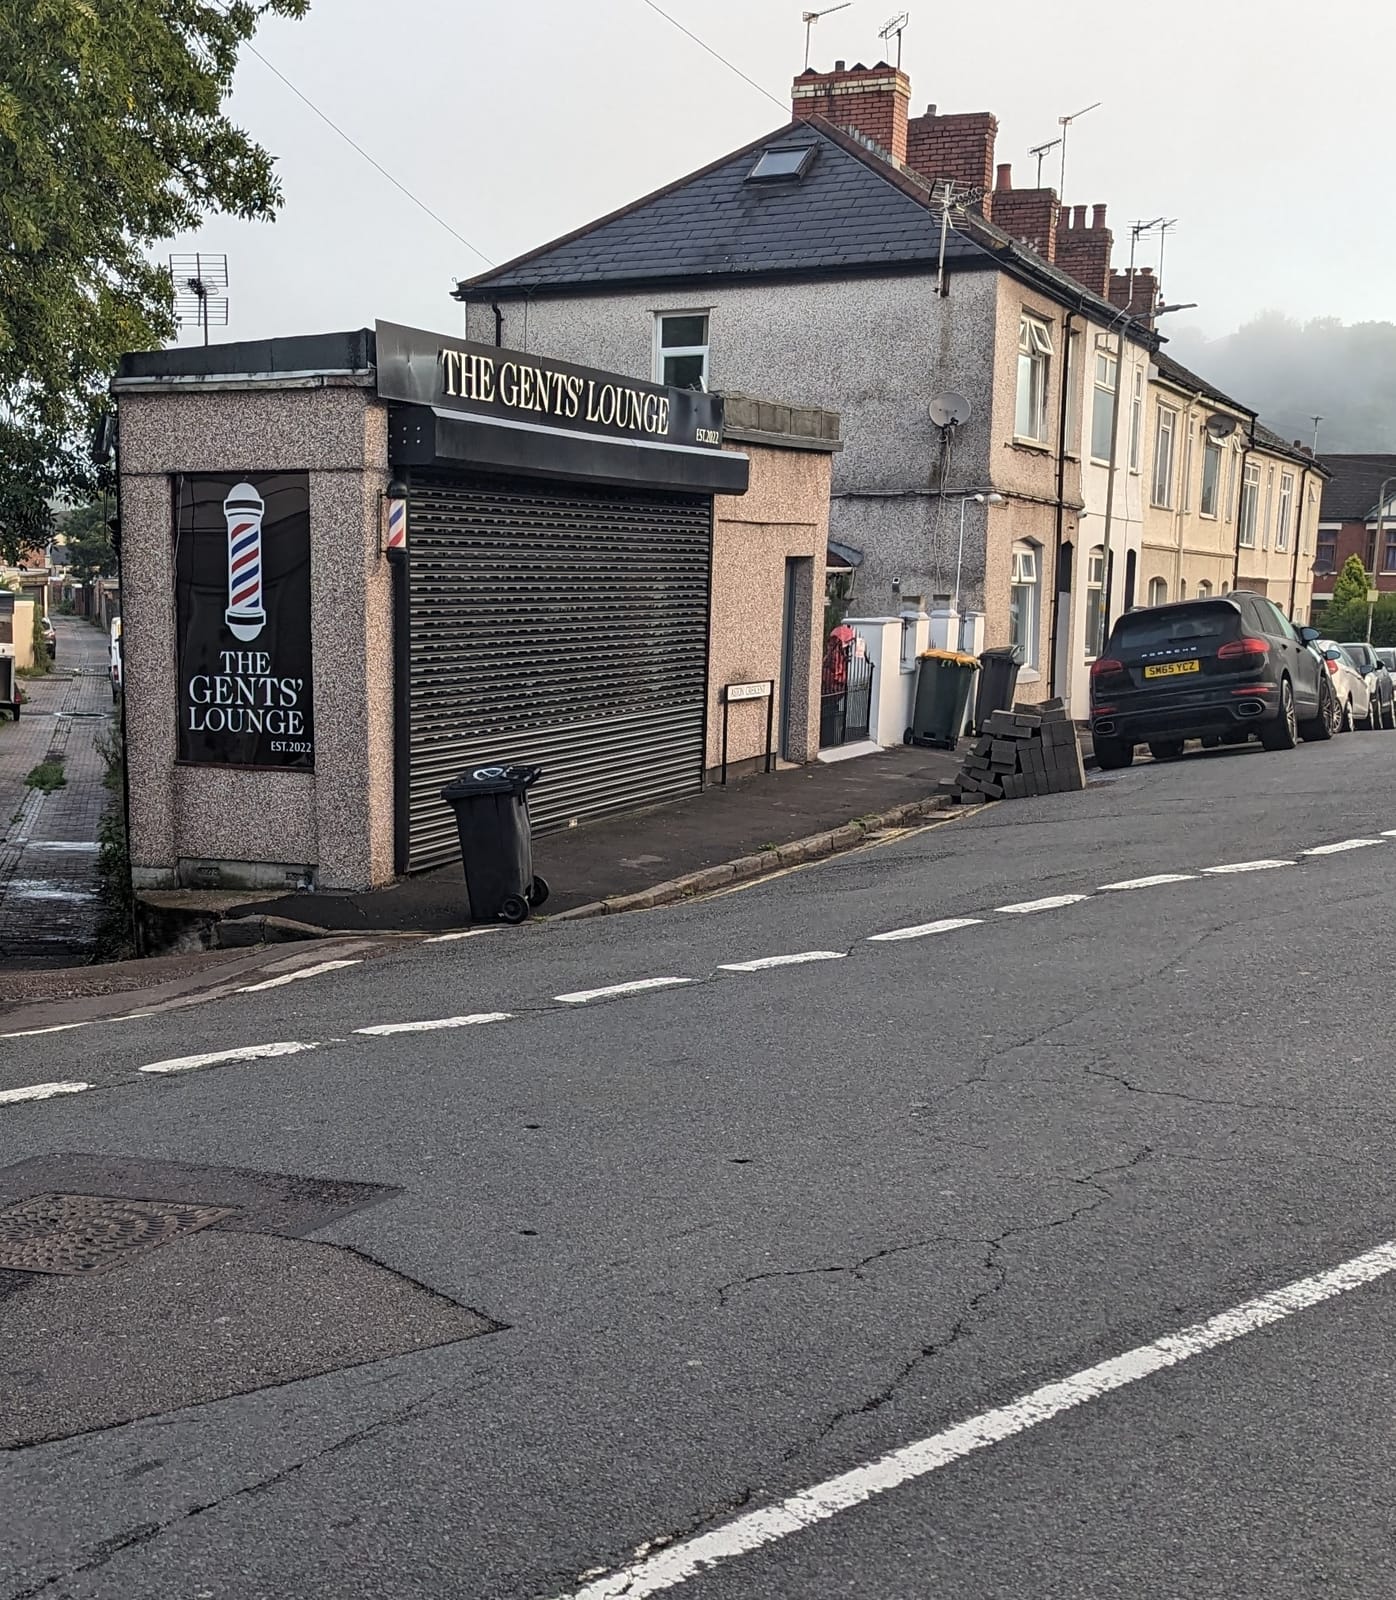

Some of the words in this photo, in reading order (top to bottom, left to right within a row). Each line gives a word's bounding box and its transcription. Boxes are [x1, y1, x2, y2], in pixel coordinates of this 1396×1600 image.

[442, 348, 495, 402] THE
[500, 361, 584, 418] GENTS'
[585, 380, 670, 435] LOUNGE
[219, 651, 271, 675] THE
[1149, 664, 1174, 675] SM65
[1176, 662, 1194, 672] YCZ
[189, 675, 303, 706] GENTS'
[188, 707, 304, 734] LOUNGE
[270, 741, 312, 753] EST.2022
